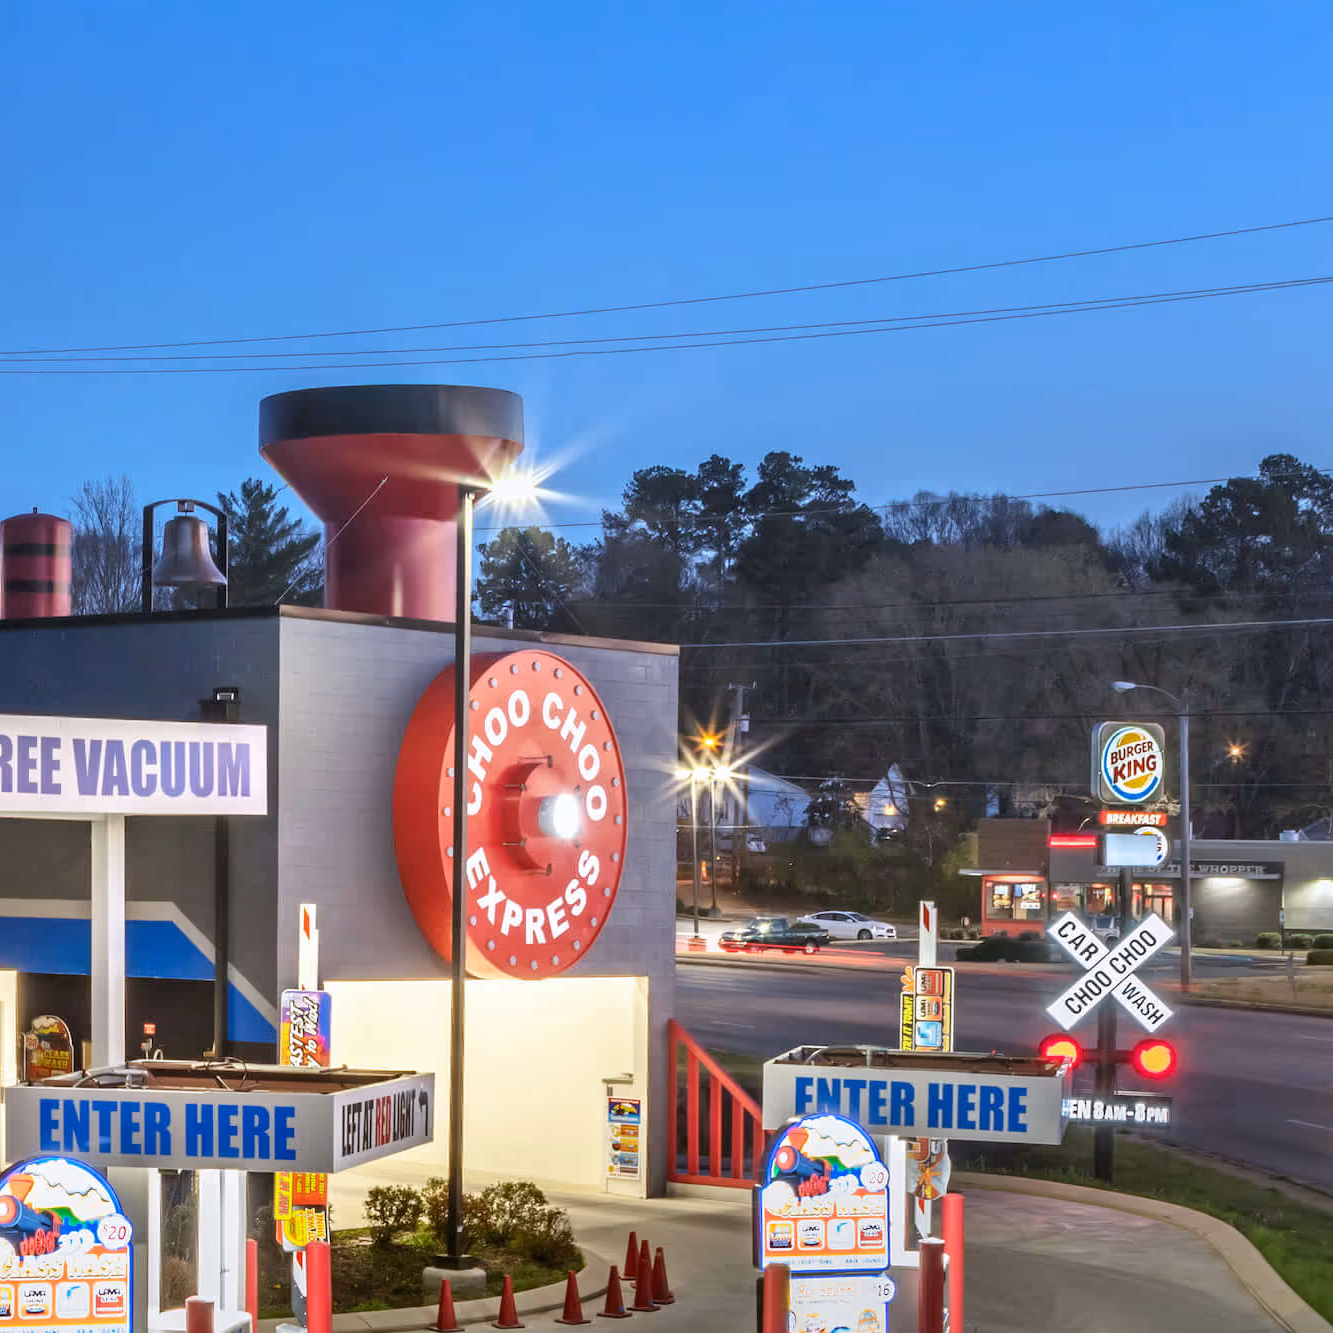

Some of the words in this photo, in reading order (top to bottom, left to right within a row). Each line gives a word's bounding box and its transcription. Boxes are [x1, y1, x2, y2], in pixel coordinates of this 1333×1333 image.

[72, 737, 252, 799] VACUUM
[467, 689, 531, 816] CHOO
[542, 692, 608, 821] CHOO
[1109, 739, 1154, 766] BURGER
[1112, 753, 1157, 785] KING
[1106, 812, 1162, 826] BREAKFAST
[465, 846, 601, 945] EXPRESS
[1198, 864, 1265, 875] WHOPPER
[1057, 920, 1099, 963] CAR
[1121, 981, 1165, 1025] WASH
[1064, 969, 1113, 1015] CHOO
[1108, 929, 1158, 975] CHOO
[289, 1000, 304, 1067] ASTEST
[39, 1098, 172, 1156] ENTER
[185, 1103, 297, 1161] HERE
[341, 1101, 363, 1157] LEFT
[362, 1099, 374, 1153] AT
[374, 1095, 392, 1148] RED
[392, 1088, 416, 1142] LIGHT
[795, 1076, 915, 1127] ENTER
[927, 1082, 1028, 1133] HERE
[1093, 1102, 1169, 1124] 8AM-8PM
[102, 1225, 127, 1240] $20
